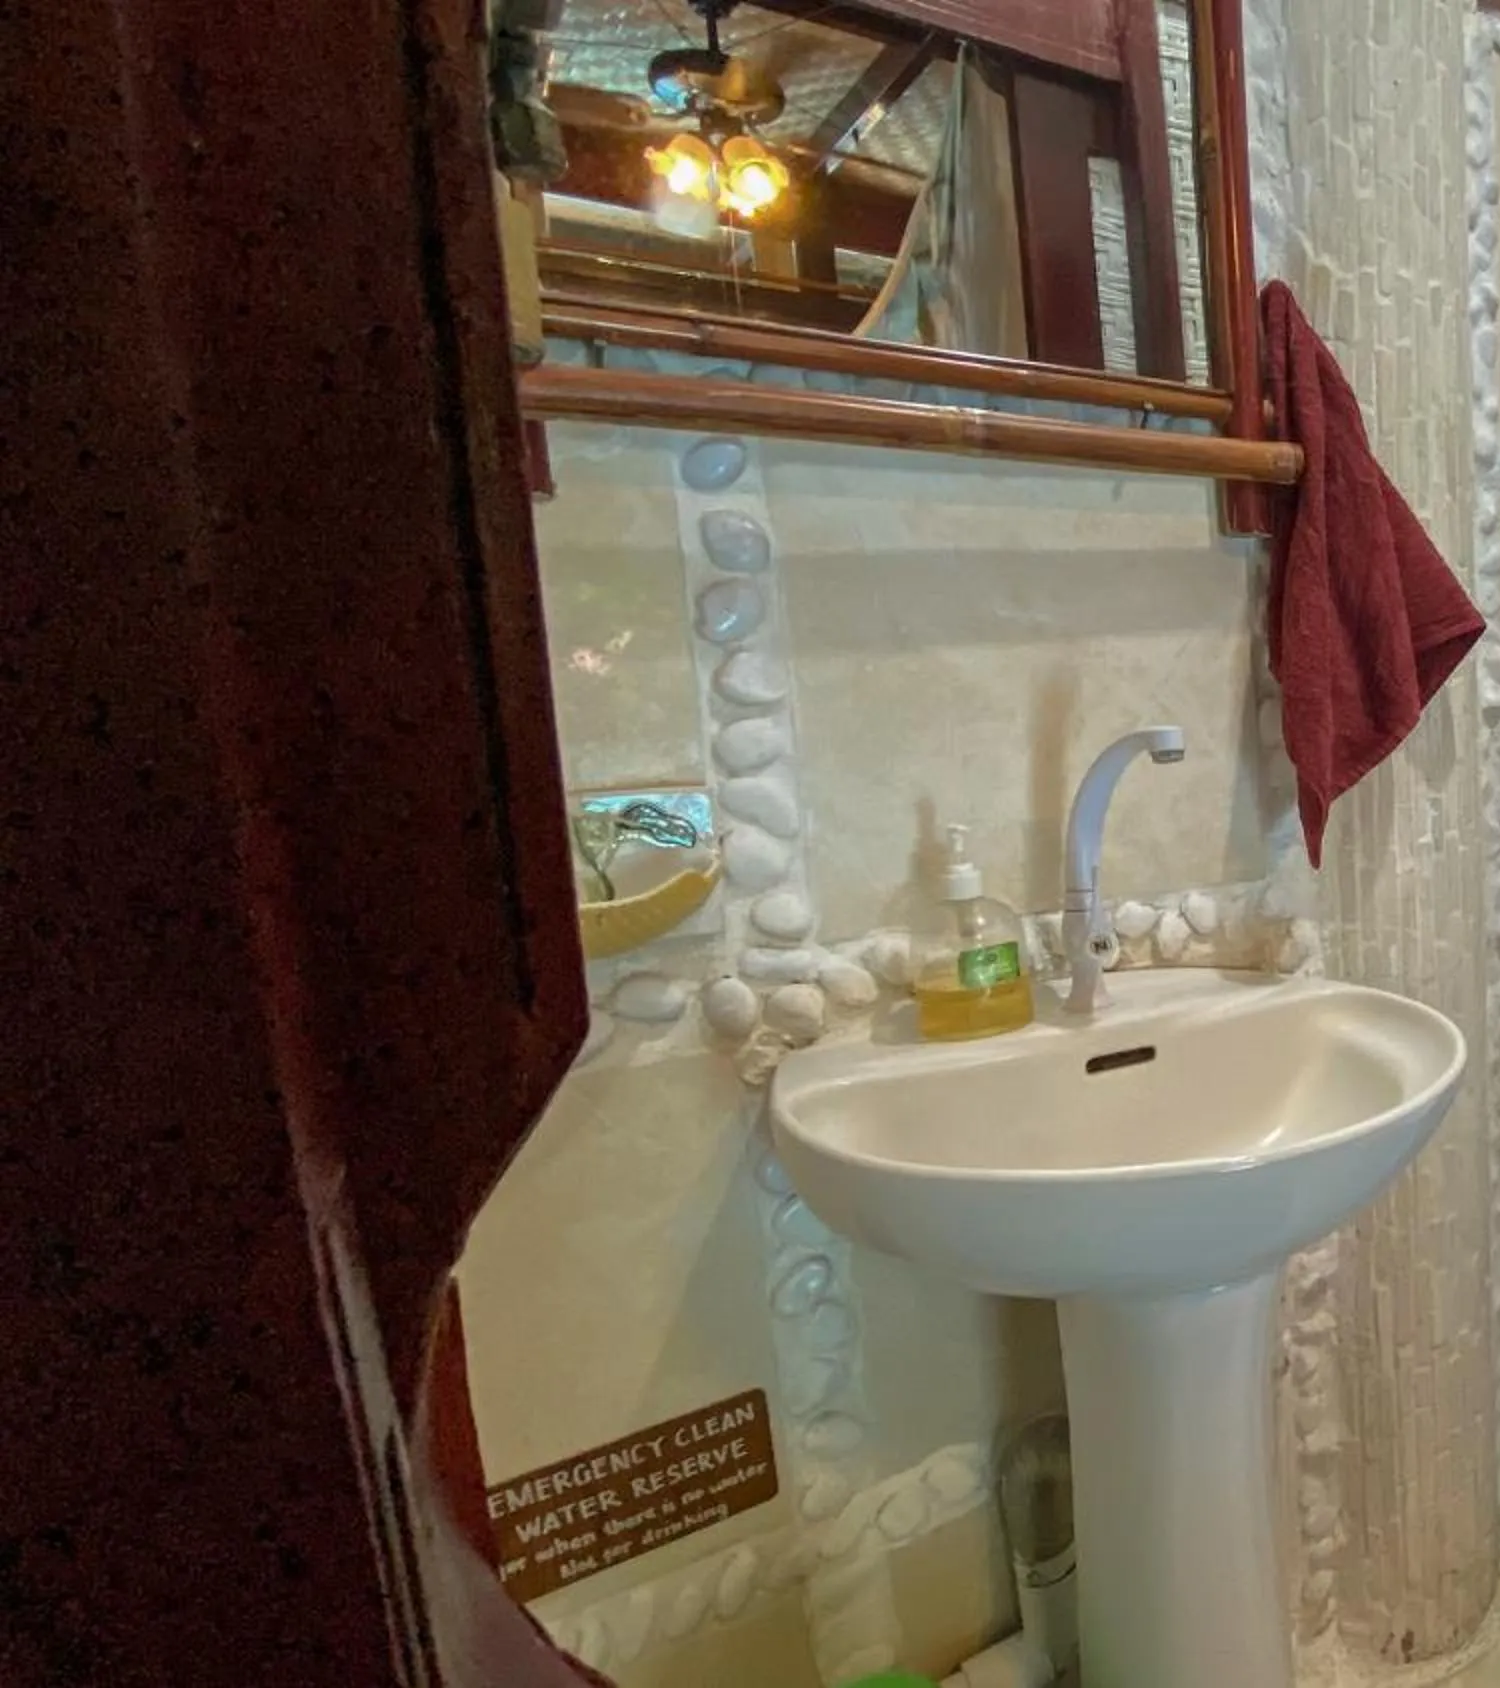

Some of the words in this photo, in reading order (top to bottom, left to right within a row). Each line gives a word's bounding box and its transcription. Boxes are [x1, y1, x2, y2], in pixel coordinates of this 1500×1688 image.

[487, 1436, 666, 1519] EMERGENCY
[674, 1403, 755, 1447] CLEAN
[516, 1489, 622, 1543] WATER
[631, 1437, 749, 1498] RESERVE
[709, 1461, 768, 1495] water
[642, 1503, 730, 1545] drinking
